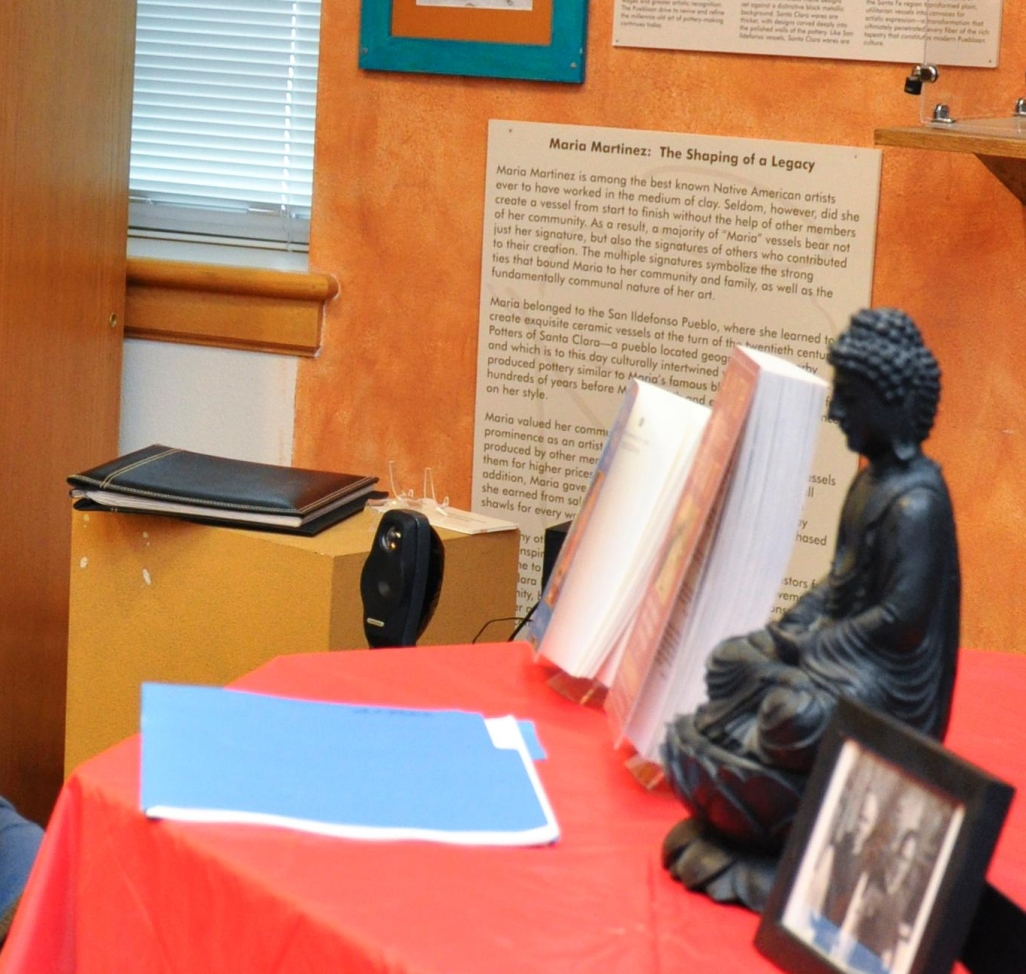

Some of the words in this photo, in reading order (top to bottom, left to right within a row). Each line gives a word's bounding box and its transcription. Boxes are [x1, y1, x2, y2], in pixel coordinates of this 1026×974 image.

[549, 138, 587, 152] Maria
[591, 141, 653, 157] Martinez:
[661, 146, 683, 160] The
[686, 148, 739, 167] Shaping
[742, 154, 756, 166] of
[759, 158, 768, 167] a
[771, 155, 816, 174] Legacy
[496, 165, 527, 177] Maria
[530, 168, 576, 181] Martinez
[579, 171, 587, 182] is
[590, 175, 627, 188] among
[630, 175, 647, 187] the
[650, 176, 672, 189] best
[675, 179, 710, 193] known
[714, 183, 748, 196] Native
[751, 186, 802, 201] American
[805, 192, 836, 204] artists
[496, 182, 519, 191] ever
[522, 182, 532, 193] to
[535, 182, 560, 195] have
[563, 186, 602, 198] worked
[605, 188, 615, 199] in
[618, 190, 635, 202] the
[638, 193, 681, 205] medium
[684, 195, 696, 207] of
[698, 197, 721, 211] clay.
[724, 199, 768, 215] Seldom,
[770, 203, 818, 220] however,
[821, 208, 839, 220] did
[841, 210, 860, 223] she
[494, 209, 505, 219] of
[508, 210, 526, 221] her
[528, 214, 588, 229] community.
[591, 218, 604, 229] As
[617, 221, 649, 234] result,
[652, 226, 659, 234] a
[662, 226, 706, 241] majority
[708, 228, 720, 240] of
[722, 230, 762, 244] "Maria"
[766, 236, 802, 248] vessels
[805, 238, 830, 251] bear
[833, 243, 851, 253] not
[495, 197, 528, 207] create
[540, 200, 572, 210] vessel
[574, 200, 599, 213] from
[602, 204, 626, 215] start
[628, 207, 639, 217] to
[642, 206, 670, 220] finish
[673, 211, 713, 224] without
[715, 214, 732, 226] the
[735, 215, 759, 230] help
[761, 218, 773, 230] of
[775, 220, 804, 232] other
[807, 225, 857, 238] members
[493, 239, 504, 249] to
[507, 239, 531, 251] their
[533, 244, 579, 256] creation.
[583, 246, 601, 258] The
[604, 250, 647, 264] multiple
[649, 254, 703, 269] signatures
[706, 260, 758, 275] symbolize
[760, 265, 778, 277] the
[781, 268, 814, 284] strong
[494, 223, 512, 236] just
[515, 225, 533, 236] her
[535, 227, 588, 244] signature,
[590, 232, 608, 244] but
[610, 234, 632, 246] also
[635, 236, 652, 248] the
[655, 239, 709, 254] signatures
[712, 244, 723, 255] of
[725, 246, 758, 259] others
[762, 250, 784, 262] who
[787, 255, 848, 269] contributed
[492, 252, 510, 264] ties
[513, 255, 534, 266] that
[537, 256, 570, 270] bound
[573, 261, 603, 274] Maria
[606, 265, 617, 275] to
[620, 265, 638, 277] her
[640, 270, 698, 286] community
[700, 275, 721, 286] and
[724, 276, 759, 292] family,
[761, 283, 774, 292] as
[776, 283, 798, 294] well
[801, 288, 814, 297] as
[816, 286, 834, 299] the
[492, 266, 566, 287] fundamentally
[568, 278, 624, 290] communal
[626, 283, 661, 295] nature
[664, 285, 675, 296] of
[677, 286, 695, 298] her
[698, 291, 716, 301] art.
[489, 313, 522, 324] create
[524, 317, 570, 329] exquisite
[572, 323, 613, 335] ceramic
[616, 328, 652, 339] vessels
[654, 331, 665, 340] at
[668, 331, 685, 343] the
[688, 334, 709, 345] turn
[712, 336, 723, 347] of
[490, 296, 520, 309] Maria
[523, 299, 572, 316] belonged
[575, 306, 586, 316] to
[588, 306, 605, 318] the
[608, 308, 628, 321] San
[631, 311, 679, 327] Ildefonso
[682, 317, 721, 333] Pueblo,
[724, 322, 756, 336] where
[759, 326, 778, 339] she
[781, 328, 822, 344] learned
[825, 335, 834, 346] to
[488, 341, 508, 352] and
[511, 343, 541, 355] which
[544, 346, 552, 357] is
[555, 348, 566, 358] to
[568, 349, 586, 361] this
[589, 351, 609, 366] day
[611, 355, 659, 372] culturally
[661, 360, 719, 377] intertwined
[489, 325, 523, 339] Potters
[526, 329, 537, 340] of
[540, 331, 569, 344] Santa
[621, 342, 658, 354] pueblo
[660, 344, 699, 360] located
[486, 386, 500, 394] on
[503, 384, 520, 396] her
[523, 388, 549, 401] style.
[485, 412, 515, 425] Maria
[517, 417, 552, 430] valued
[555, 420, 573, 432] her
